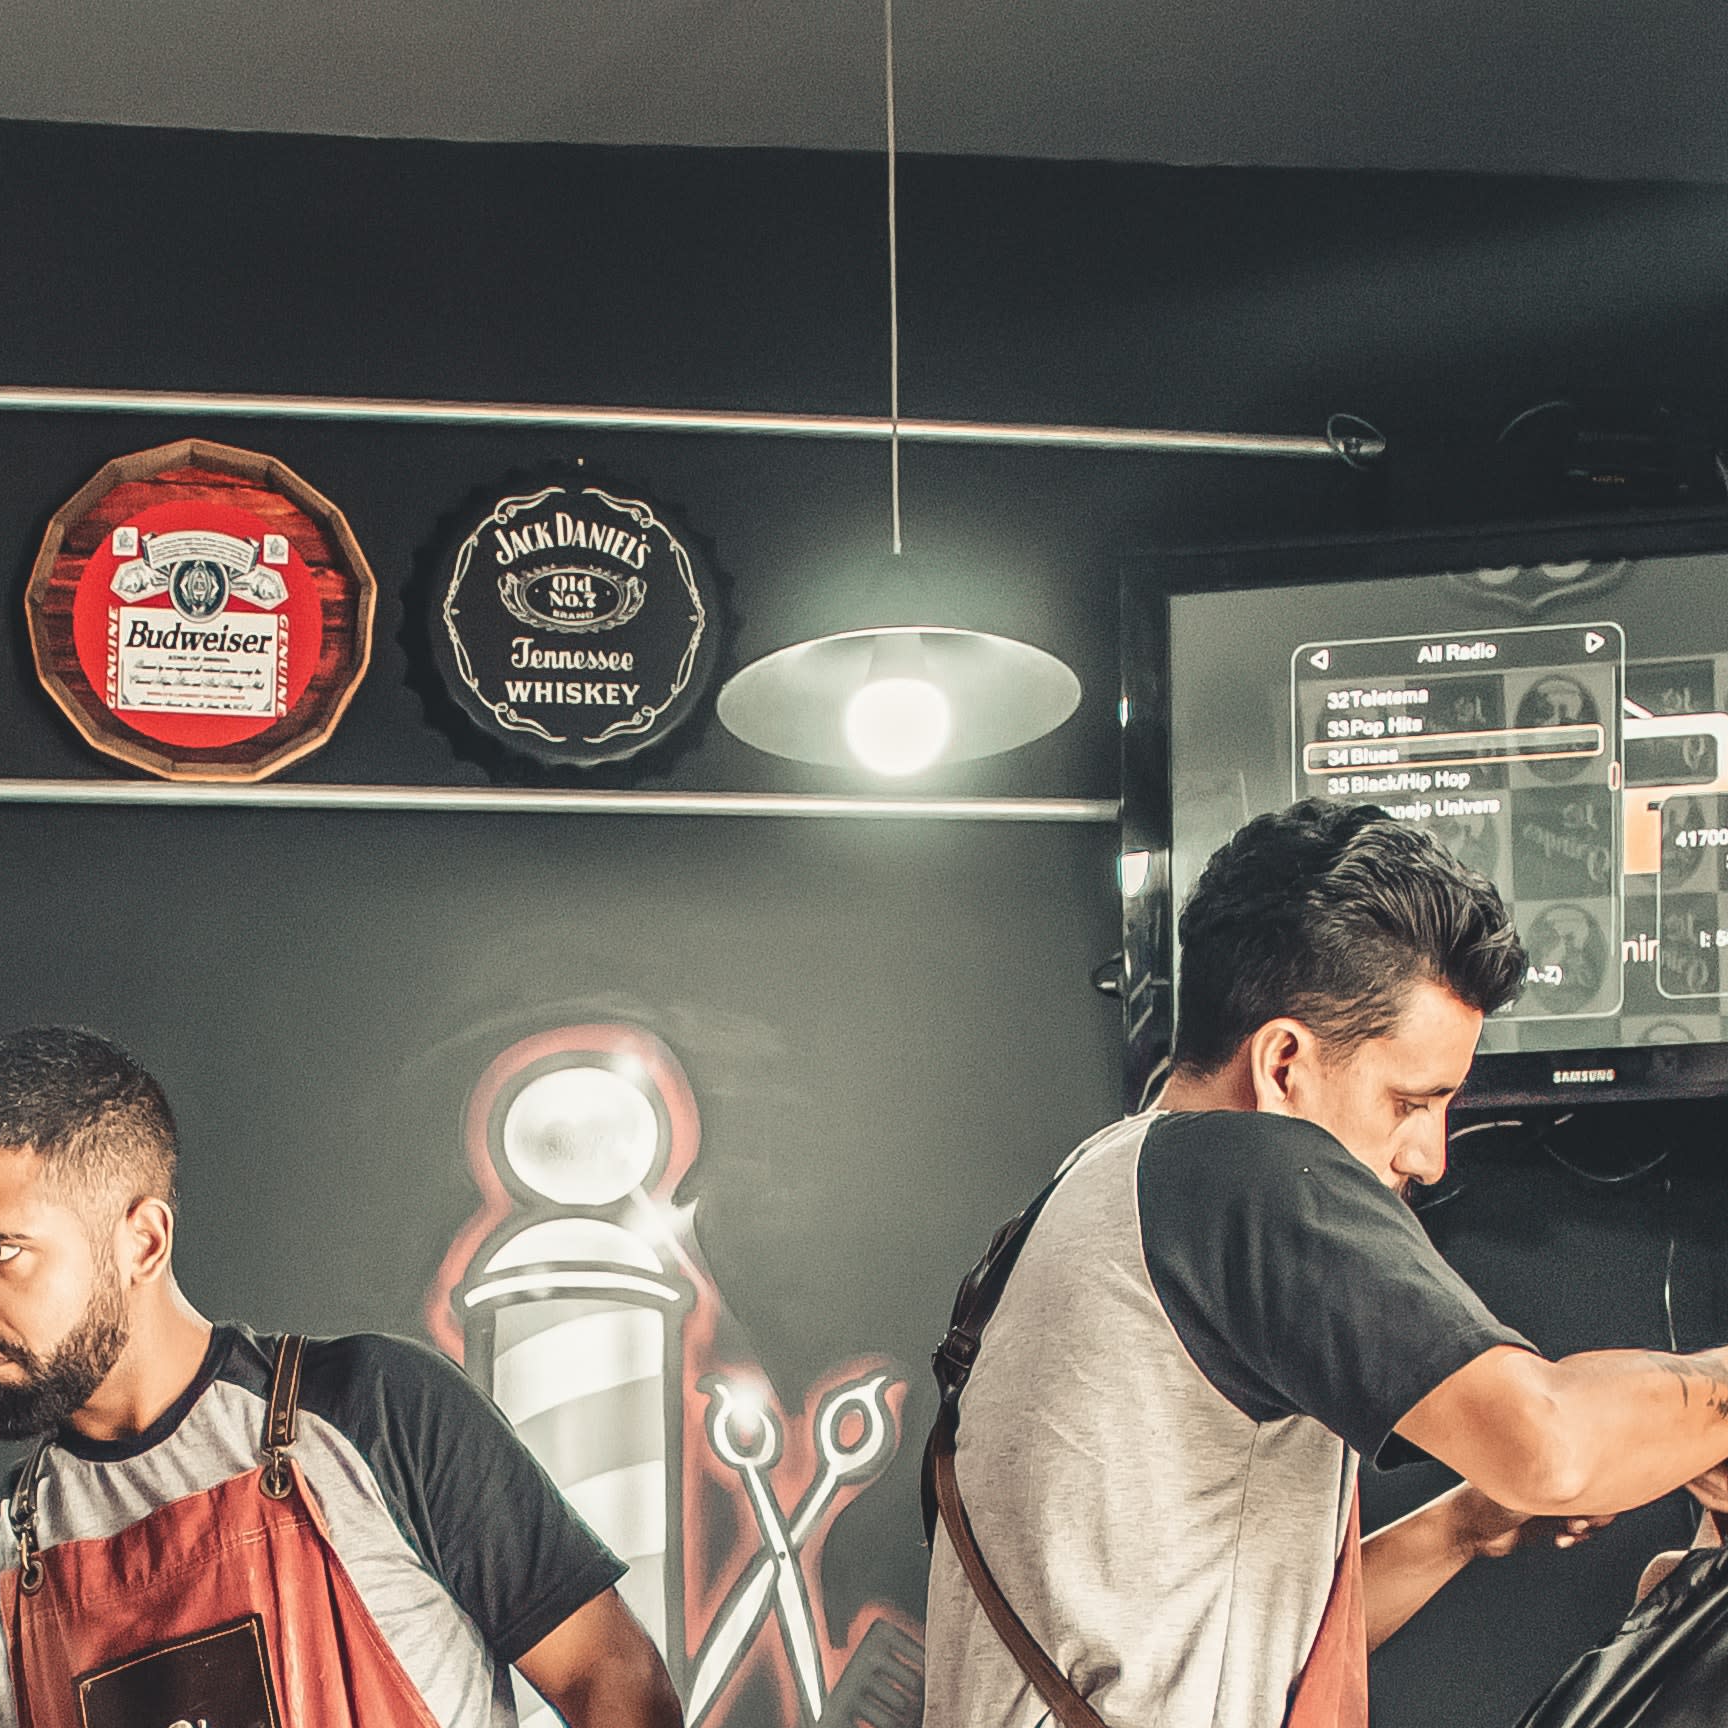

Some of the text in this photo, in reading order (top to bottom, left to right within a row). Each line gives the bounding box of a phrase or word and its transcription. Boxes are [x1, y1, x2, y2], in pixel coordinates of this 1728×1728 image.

[494, 512, 651, 570] JACK DANIEL'S
[552, 575, 592, 594] Old
[125, 619, 273, 655] Budweiser
[106, 605, 119, 709] GENUINE
[511, 637, 634, 671] Tennessee
[1417, 642, 1498, 663] All Radio
[277, 614, 289, 718] GENUINE
[505, 681, 640, 705] WHISKEY
[1350, 719, 1385, 738] Pop
[1327, 776, 1349, 795] 35
[1435, 771, 1471, 790] Hop
[1553, 1069, 1616, 1084] SAMSUNG
